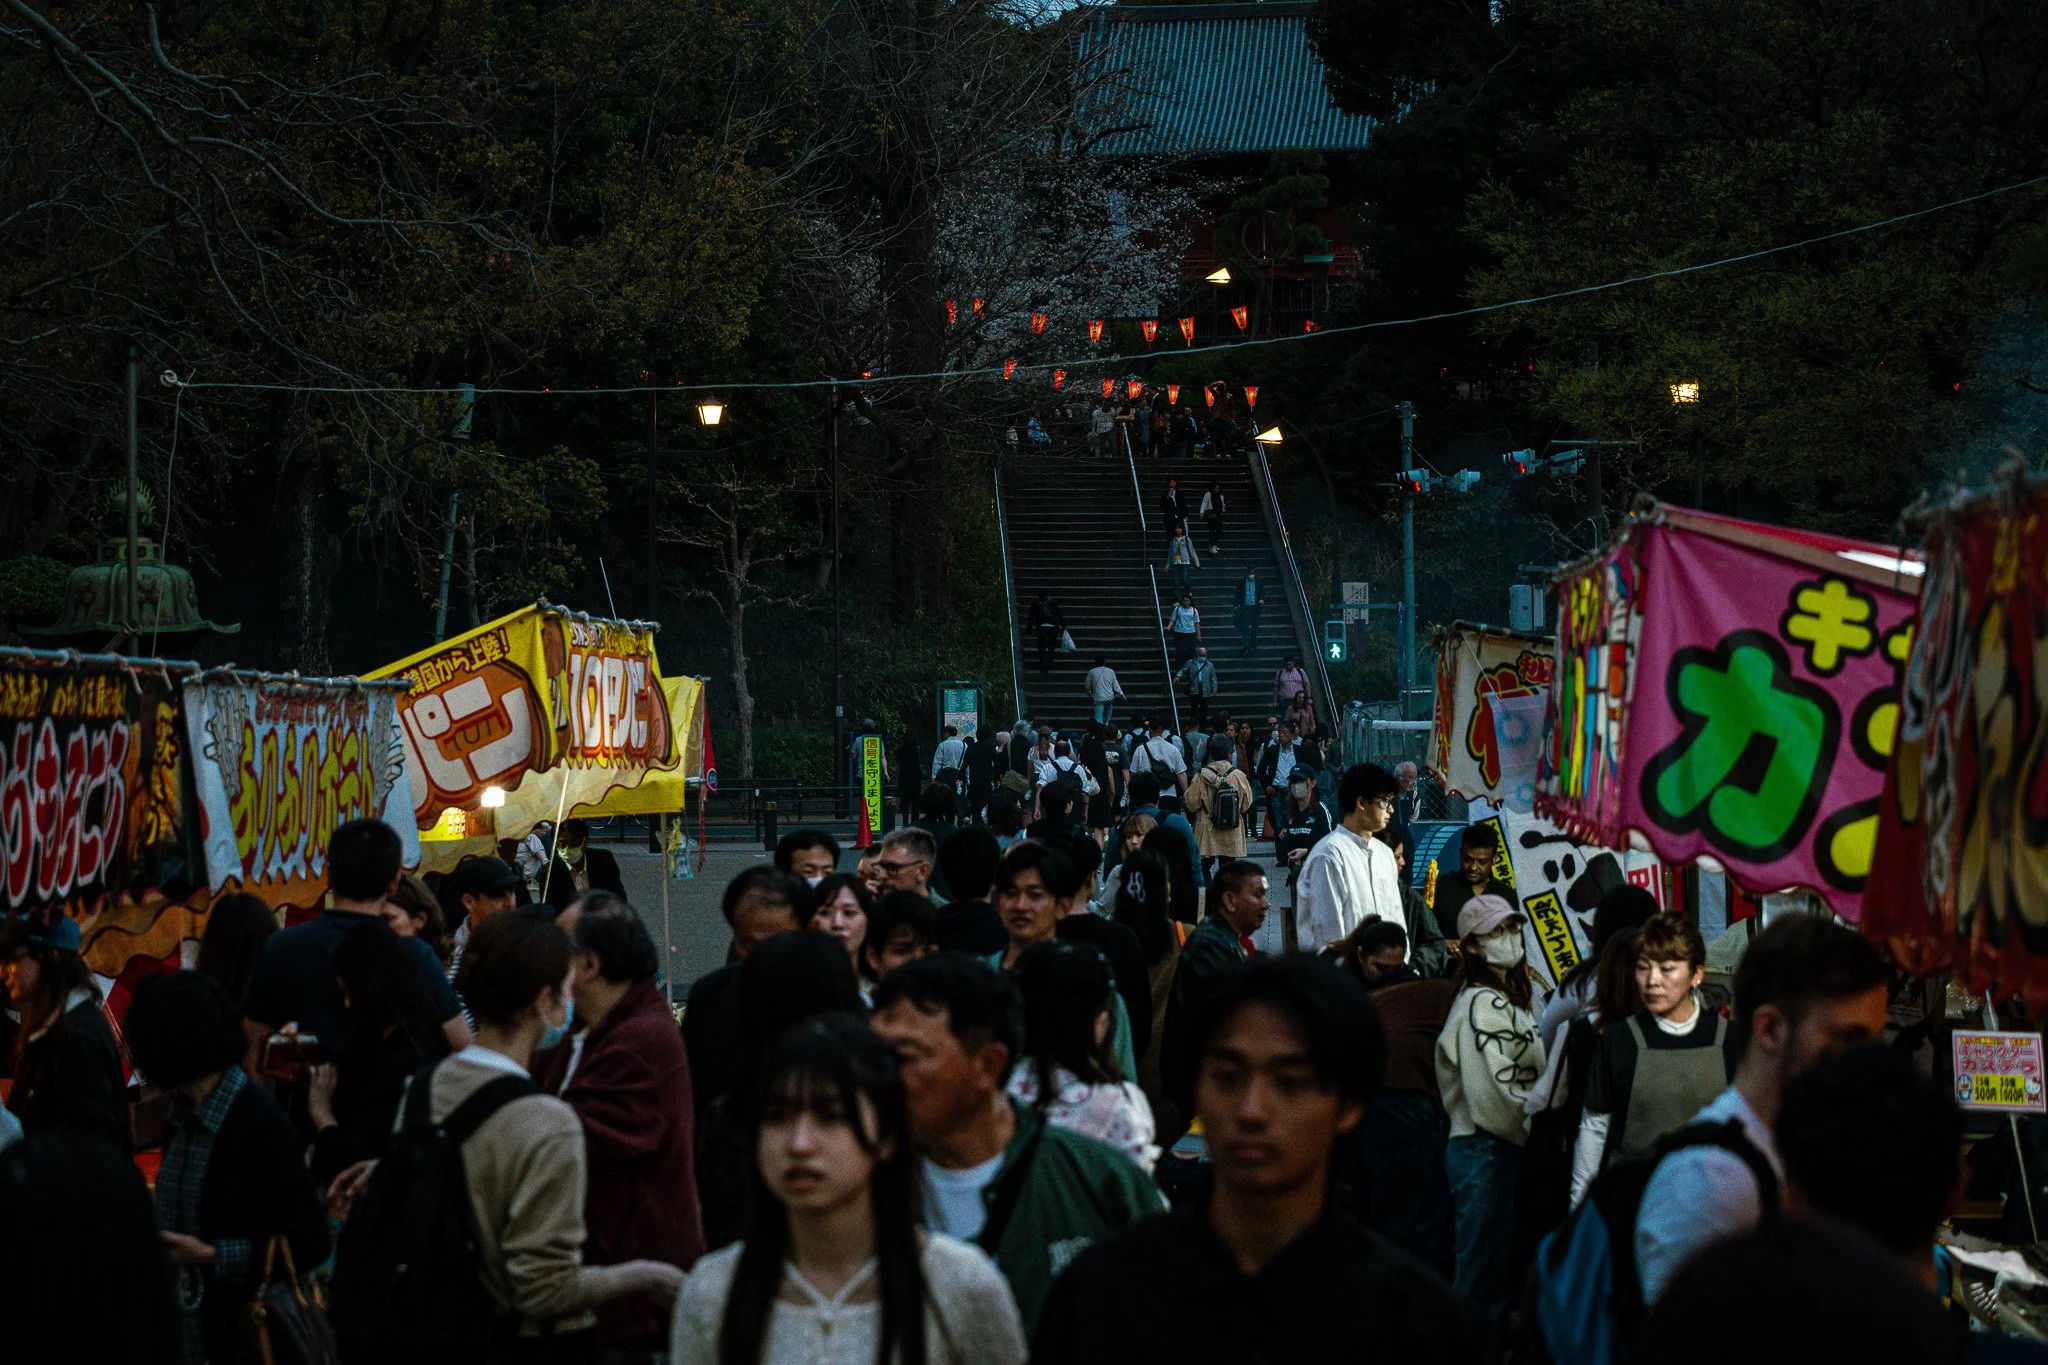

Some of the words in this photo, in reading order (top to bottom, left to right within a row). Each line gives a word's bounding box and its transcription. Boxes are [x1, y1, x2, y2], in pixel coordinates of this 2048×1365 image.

[865, 738, 879, 828] 信号を守りましょう
[1960, 1044, 2035, 1059] キャラクター
[1962, 1059, 2038, 1074] カステラ
